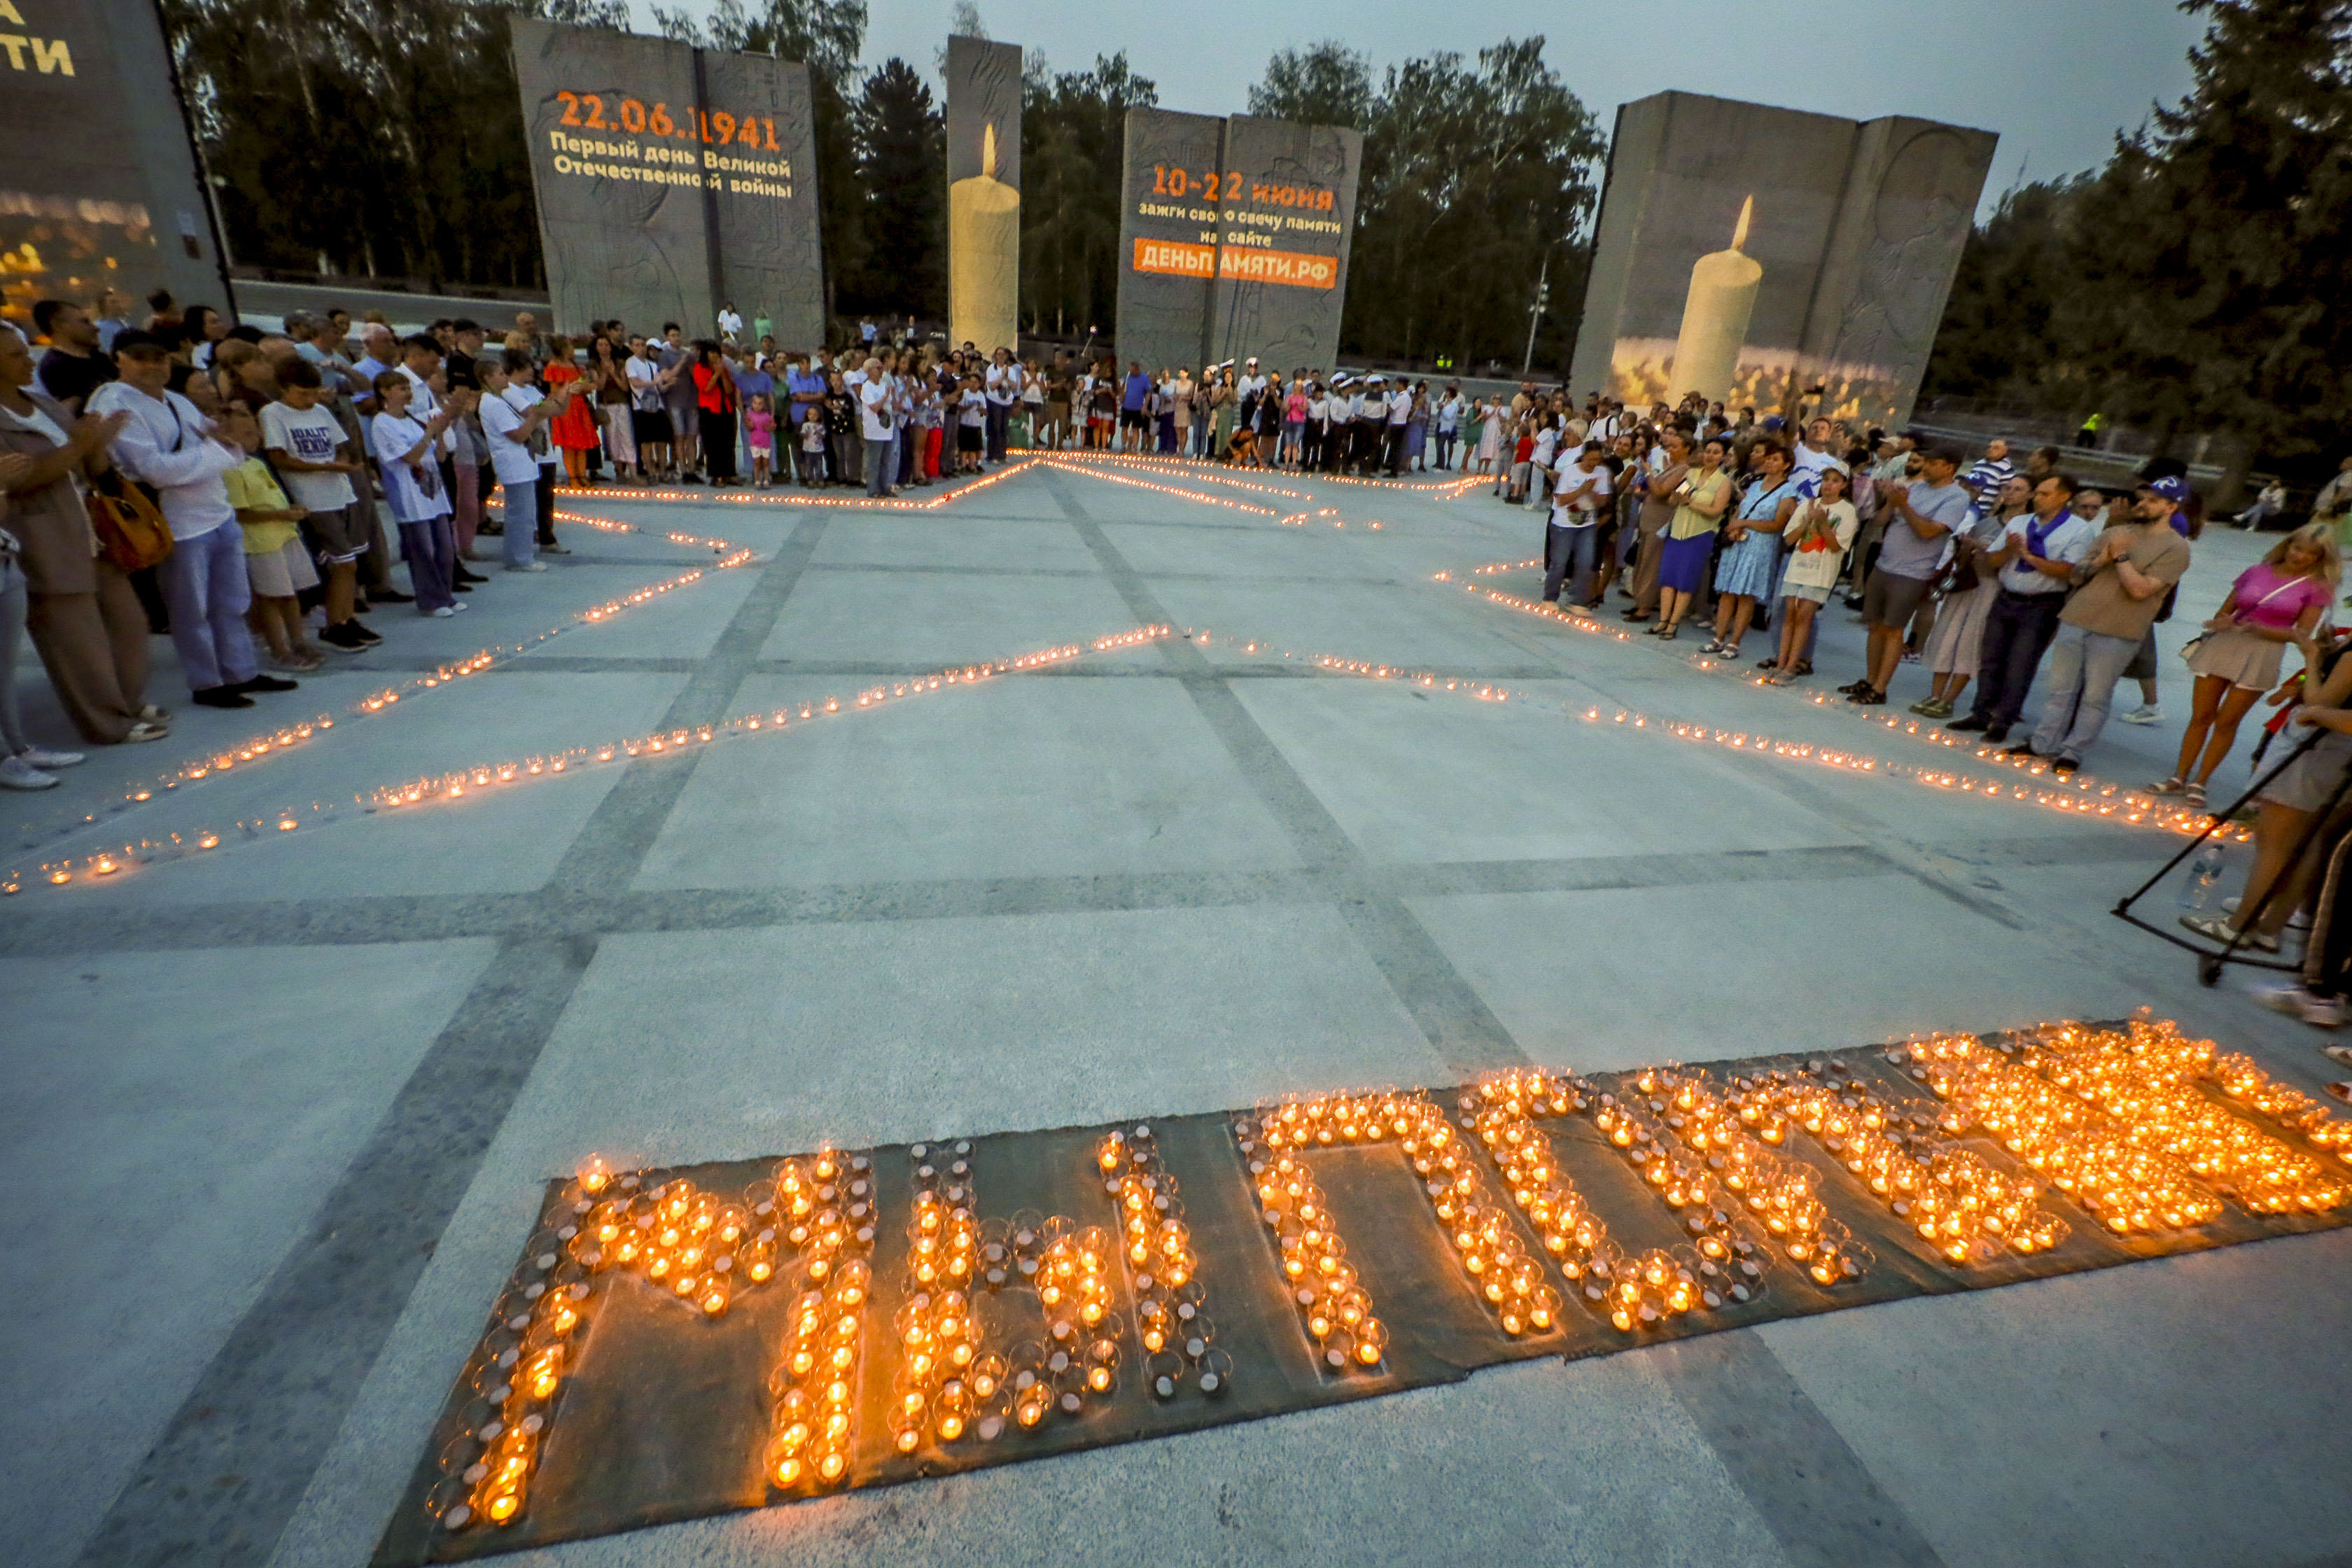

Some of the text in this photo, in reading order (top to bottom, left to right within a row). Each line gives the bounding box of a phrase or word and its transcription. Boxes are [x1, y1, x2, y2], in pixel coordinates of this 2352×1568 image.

[557, 91, 780, 151] 22.06.1941
[550, 130, 791, 178] Первый день Великой
[554, 155, 792, 198] Отечественной войны
[1154, 164, 1334, 210] 10-22 июня
[1139, 202, 1186, 218] зажги
[1238, 211, 1283, 231] свечу
[1287, 217, 1342, 234] памяти
[1200, 230, 1272, 247] на сайте
[1142, 246, 1329, 280] ДЕНЬПАМЯТИ.РФ
